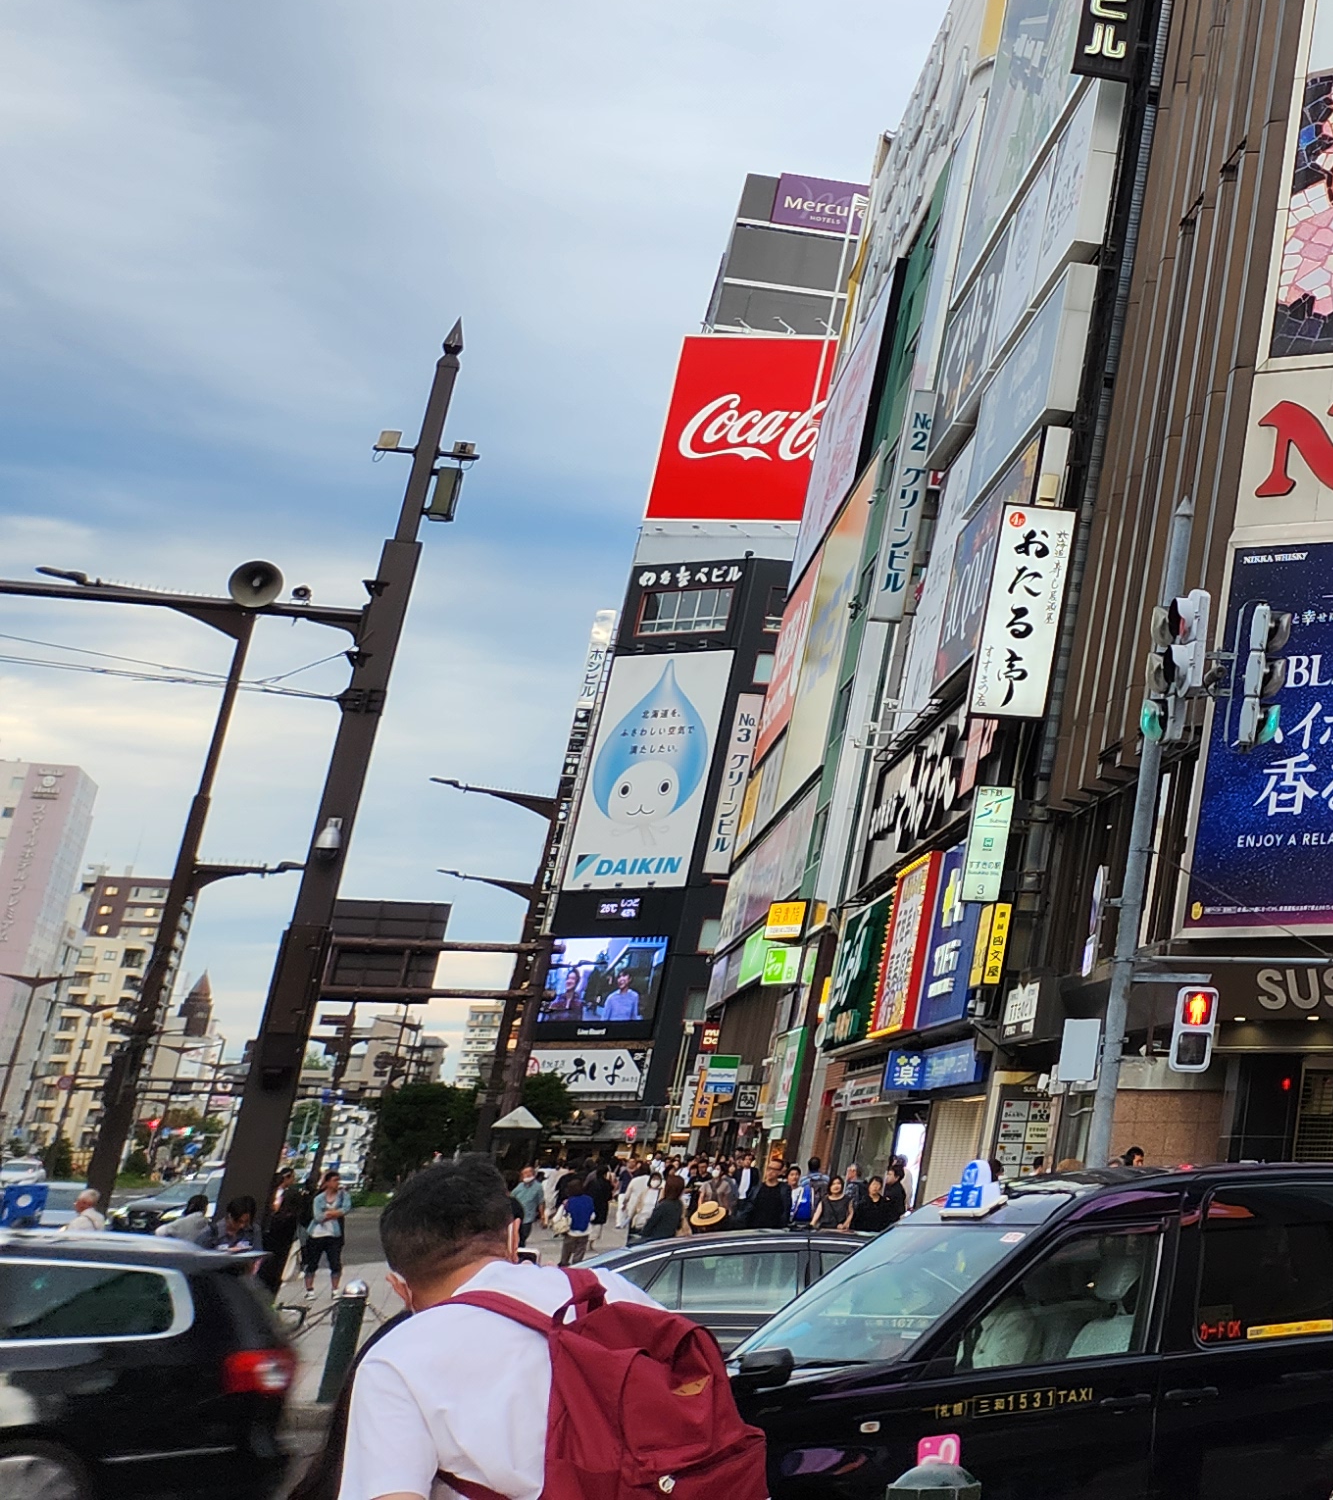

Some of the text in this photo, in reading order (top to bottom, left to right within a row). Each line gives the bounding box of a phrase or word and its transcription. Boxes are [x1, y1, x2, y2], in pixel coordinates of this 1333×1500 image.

[809, 214, 841, 225] HOTELS
[880, 467, 927, 593] グリーンビル
[1243, 551, 1309, 565] NIKKA WHISKY
[997, 528, 1051, 708] おたる亭
[641, 708, 681, 720] 北海道を、
[711, 753, 749, 854] グリーンビル
[1236, 834, 1285, 849] ENJOY
[1287, 833, 1297, 847] A
[594, 856, 684, 877] DAIKIN
[976, 884, 984, 895] 3
[707, 1071, 736, 1080] FamilyMart
[1200, 1321, 1226, 1341] カード
[1227, 1319, 1241, 1337] OK
[1008, 1388, 1055, 1410] 1531
[1058, 1386, 1093, 1404] TAXI
